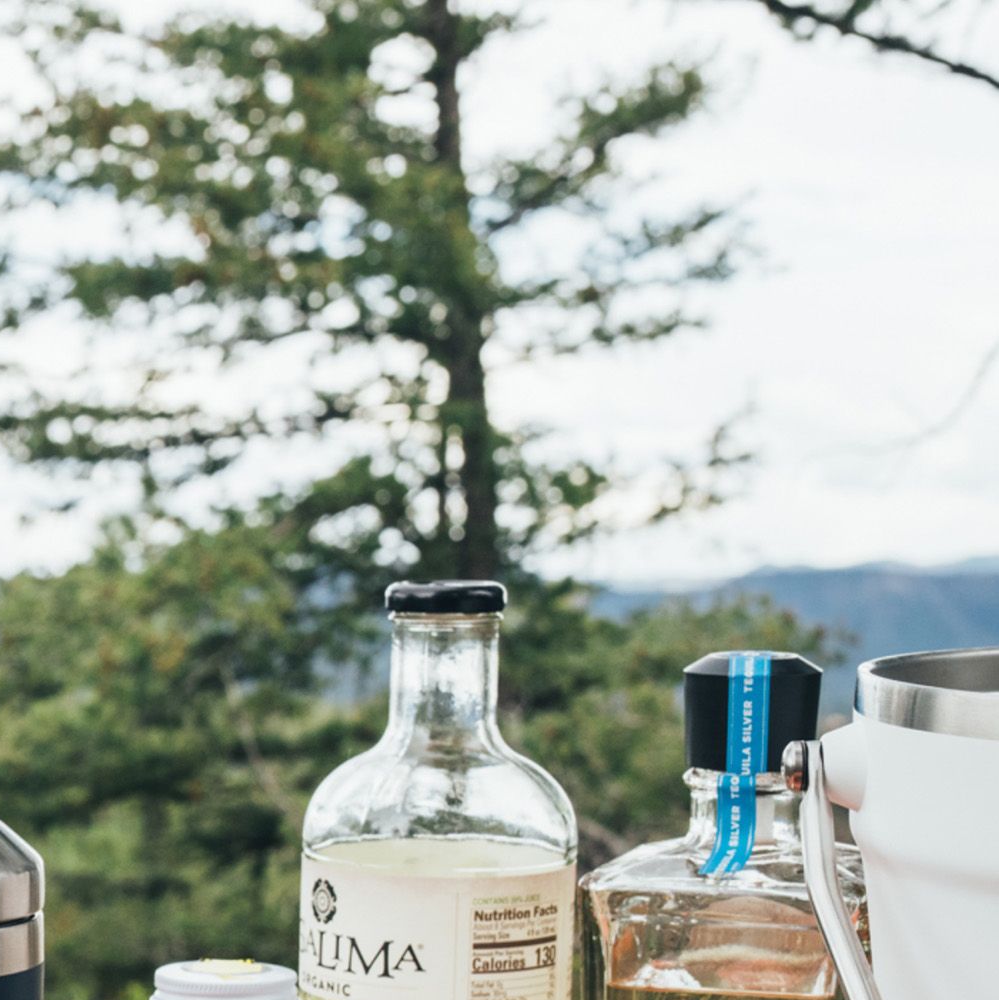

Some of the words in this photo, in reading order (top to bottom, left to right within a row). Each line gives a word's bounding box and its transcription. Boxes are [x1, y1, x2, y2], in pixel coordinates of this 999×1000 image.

[742, 700, 754, 744] SILVER
[728, 805, 741, 847] SILVER
[474, 908, 531, 921] Nutrition
[533, 904, 558, 918] Facts
[472, 957, 526, 972] Calories
[535, 944, 556, 967] 130
